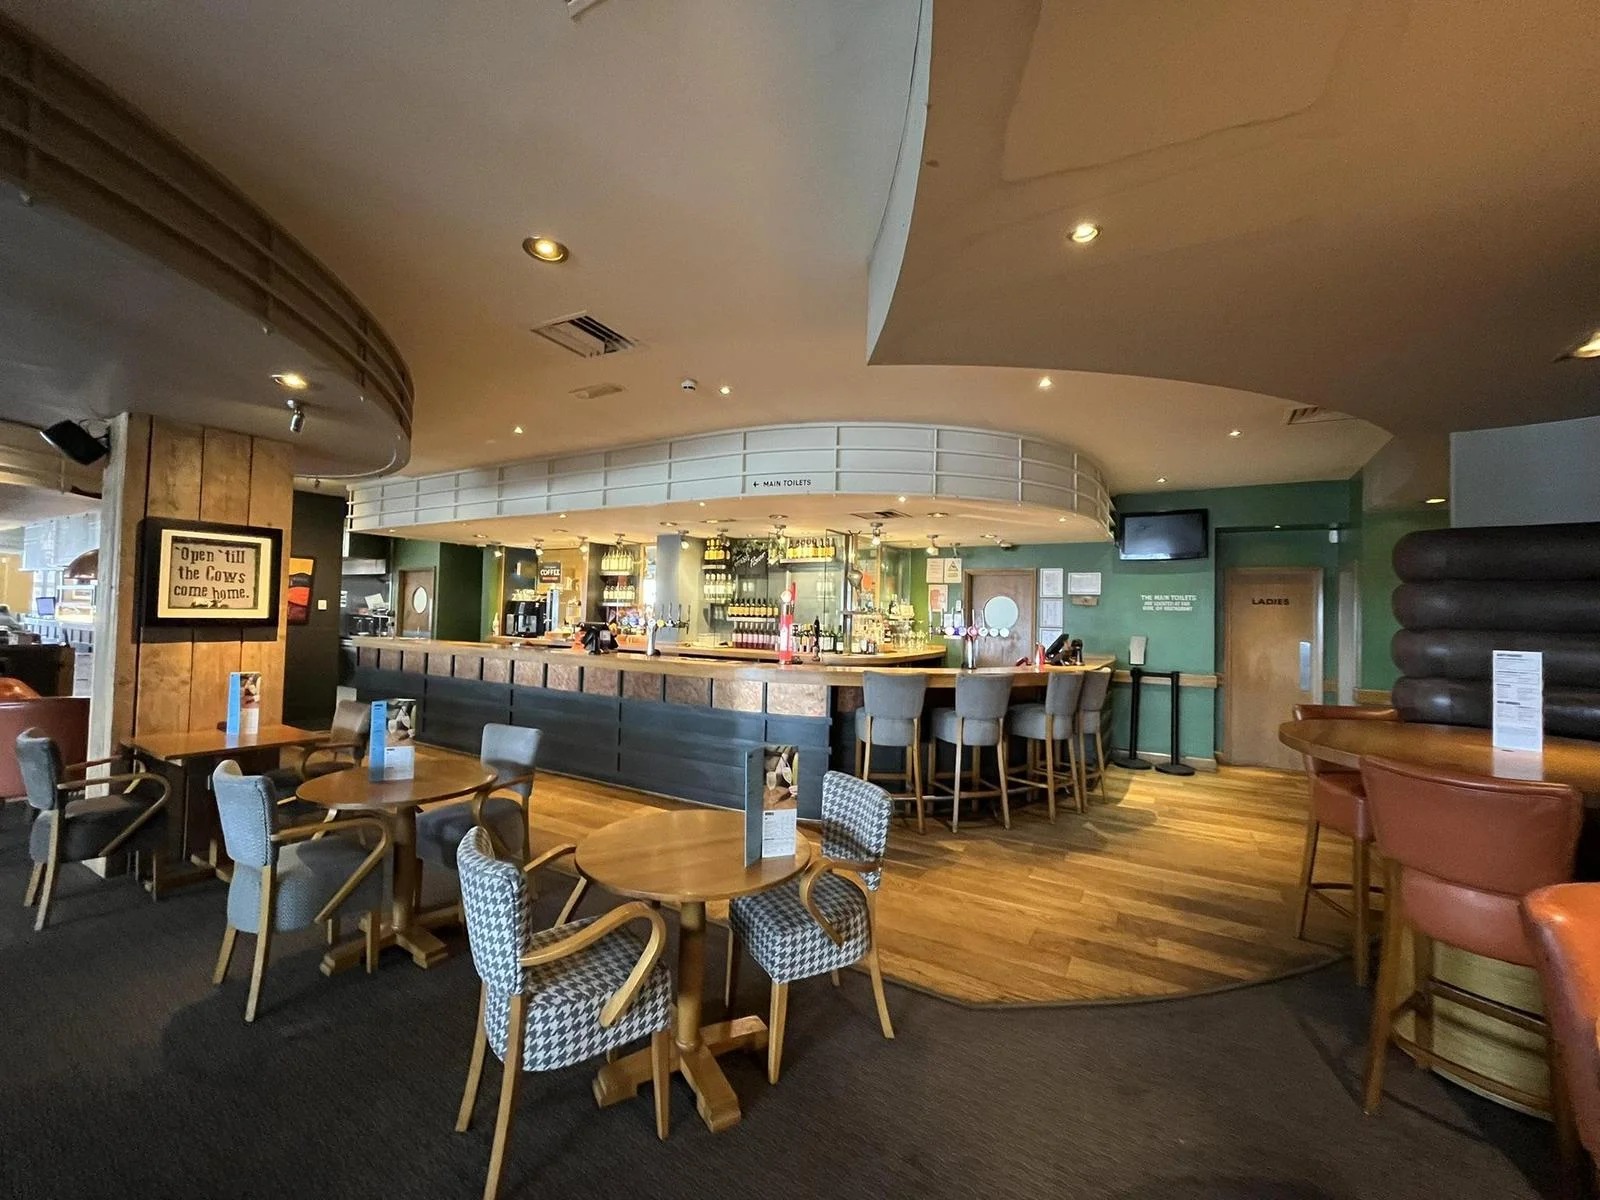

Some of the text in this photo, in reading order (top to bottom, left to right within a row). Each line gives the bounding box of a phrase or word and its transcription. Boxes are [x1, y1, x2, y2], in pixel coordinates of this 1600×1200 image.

[178, 566, 246, 583] the Cows
[174, 585, 250, 600] come home.
